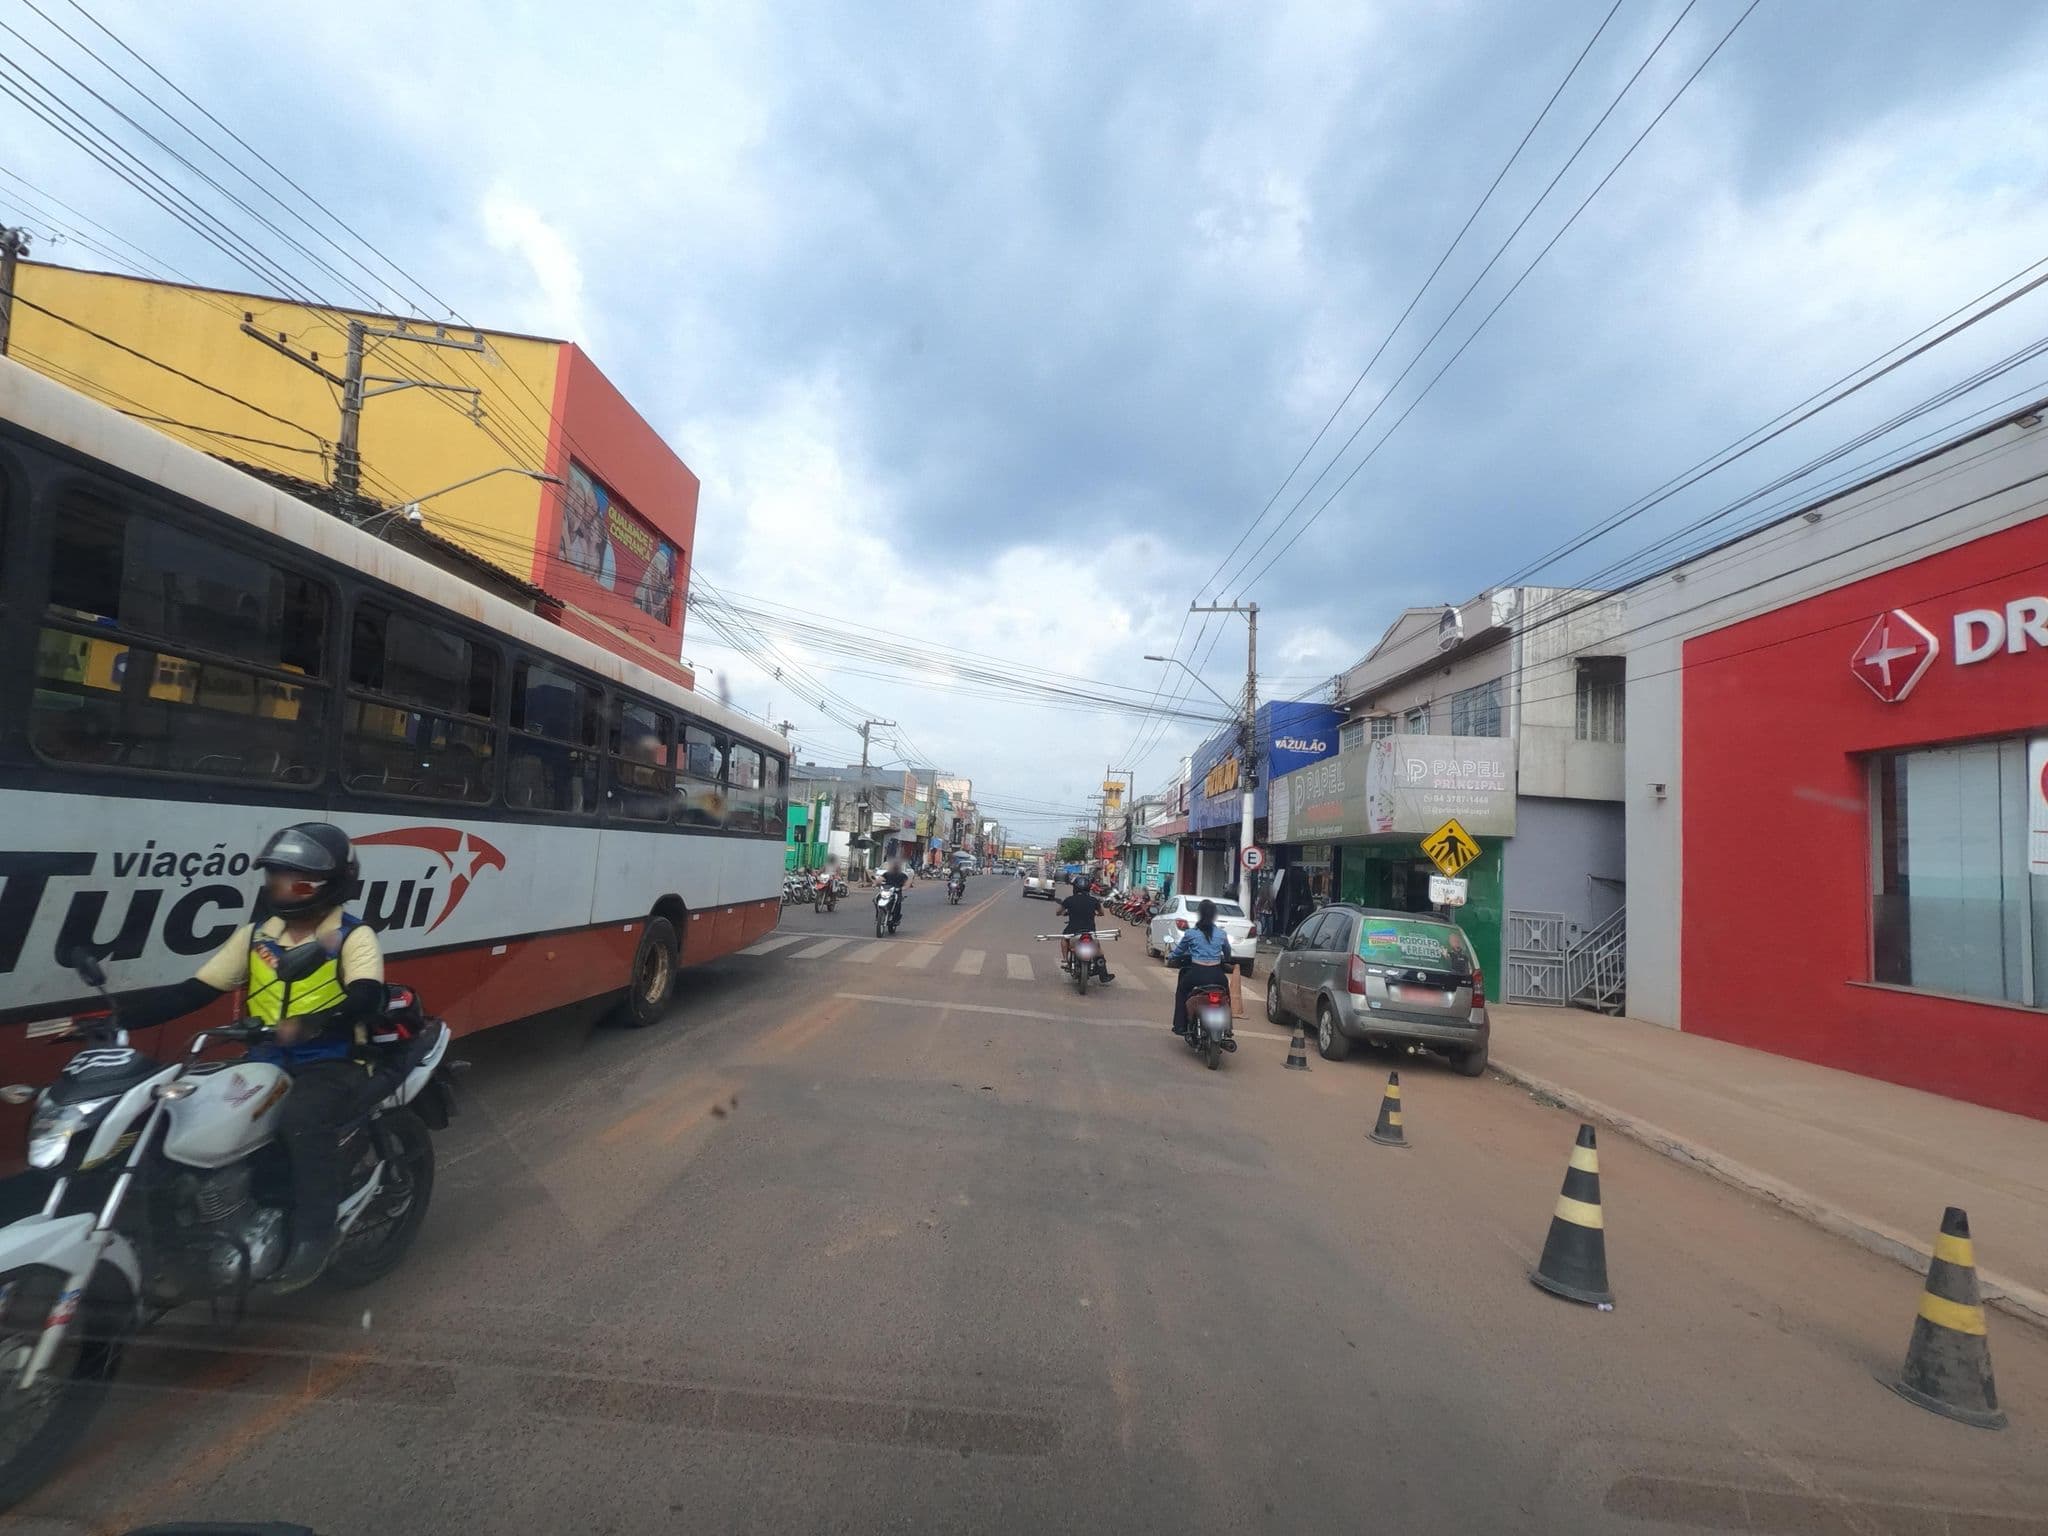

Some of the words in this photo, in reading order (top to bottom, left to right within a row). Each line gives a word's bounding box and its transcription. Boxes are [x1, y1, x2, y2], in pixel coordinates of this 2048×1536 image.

[1432, 759, 1505, 778] PAPEL
[1433, 779, 1505, 791] PRINCIPAL
[113, 839, 250, 888] viação
[1247, 851, 1257, 865] E
[0, 850, 438, 974] Tucuí
[1399, 935, 1440, 948] RODOLFO
[1406, 944, 1442, 958] FREITAS
